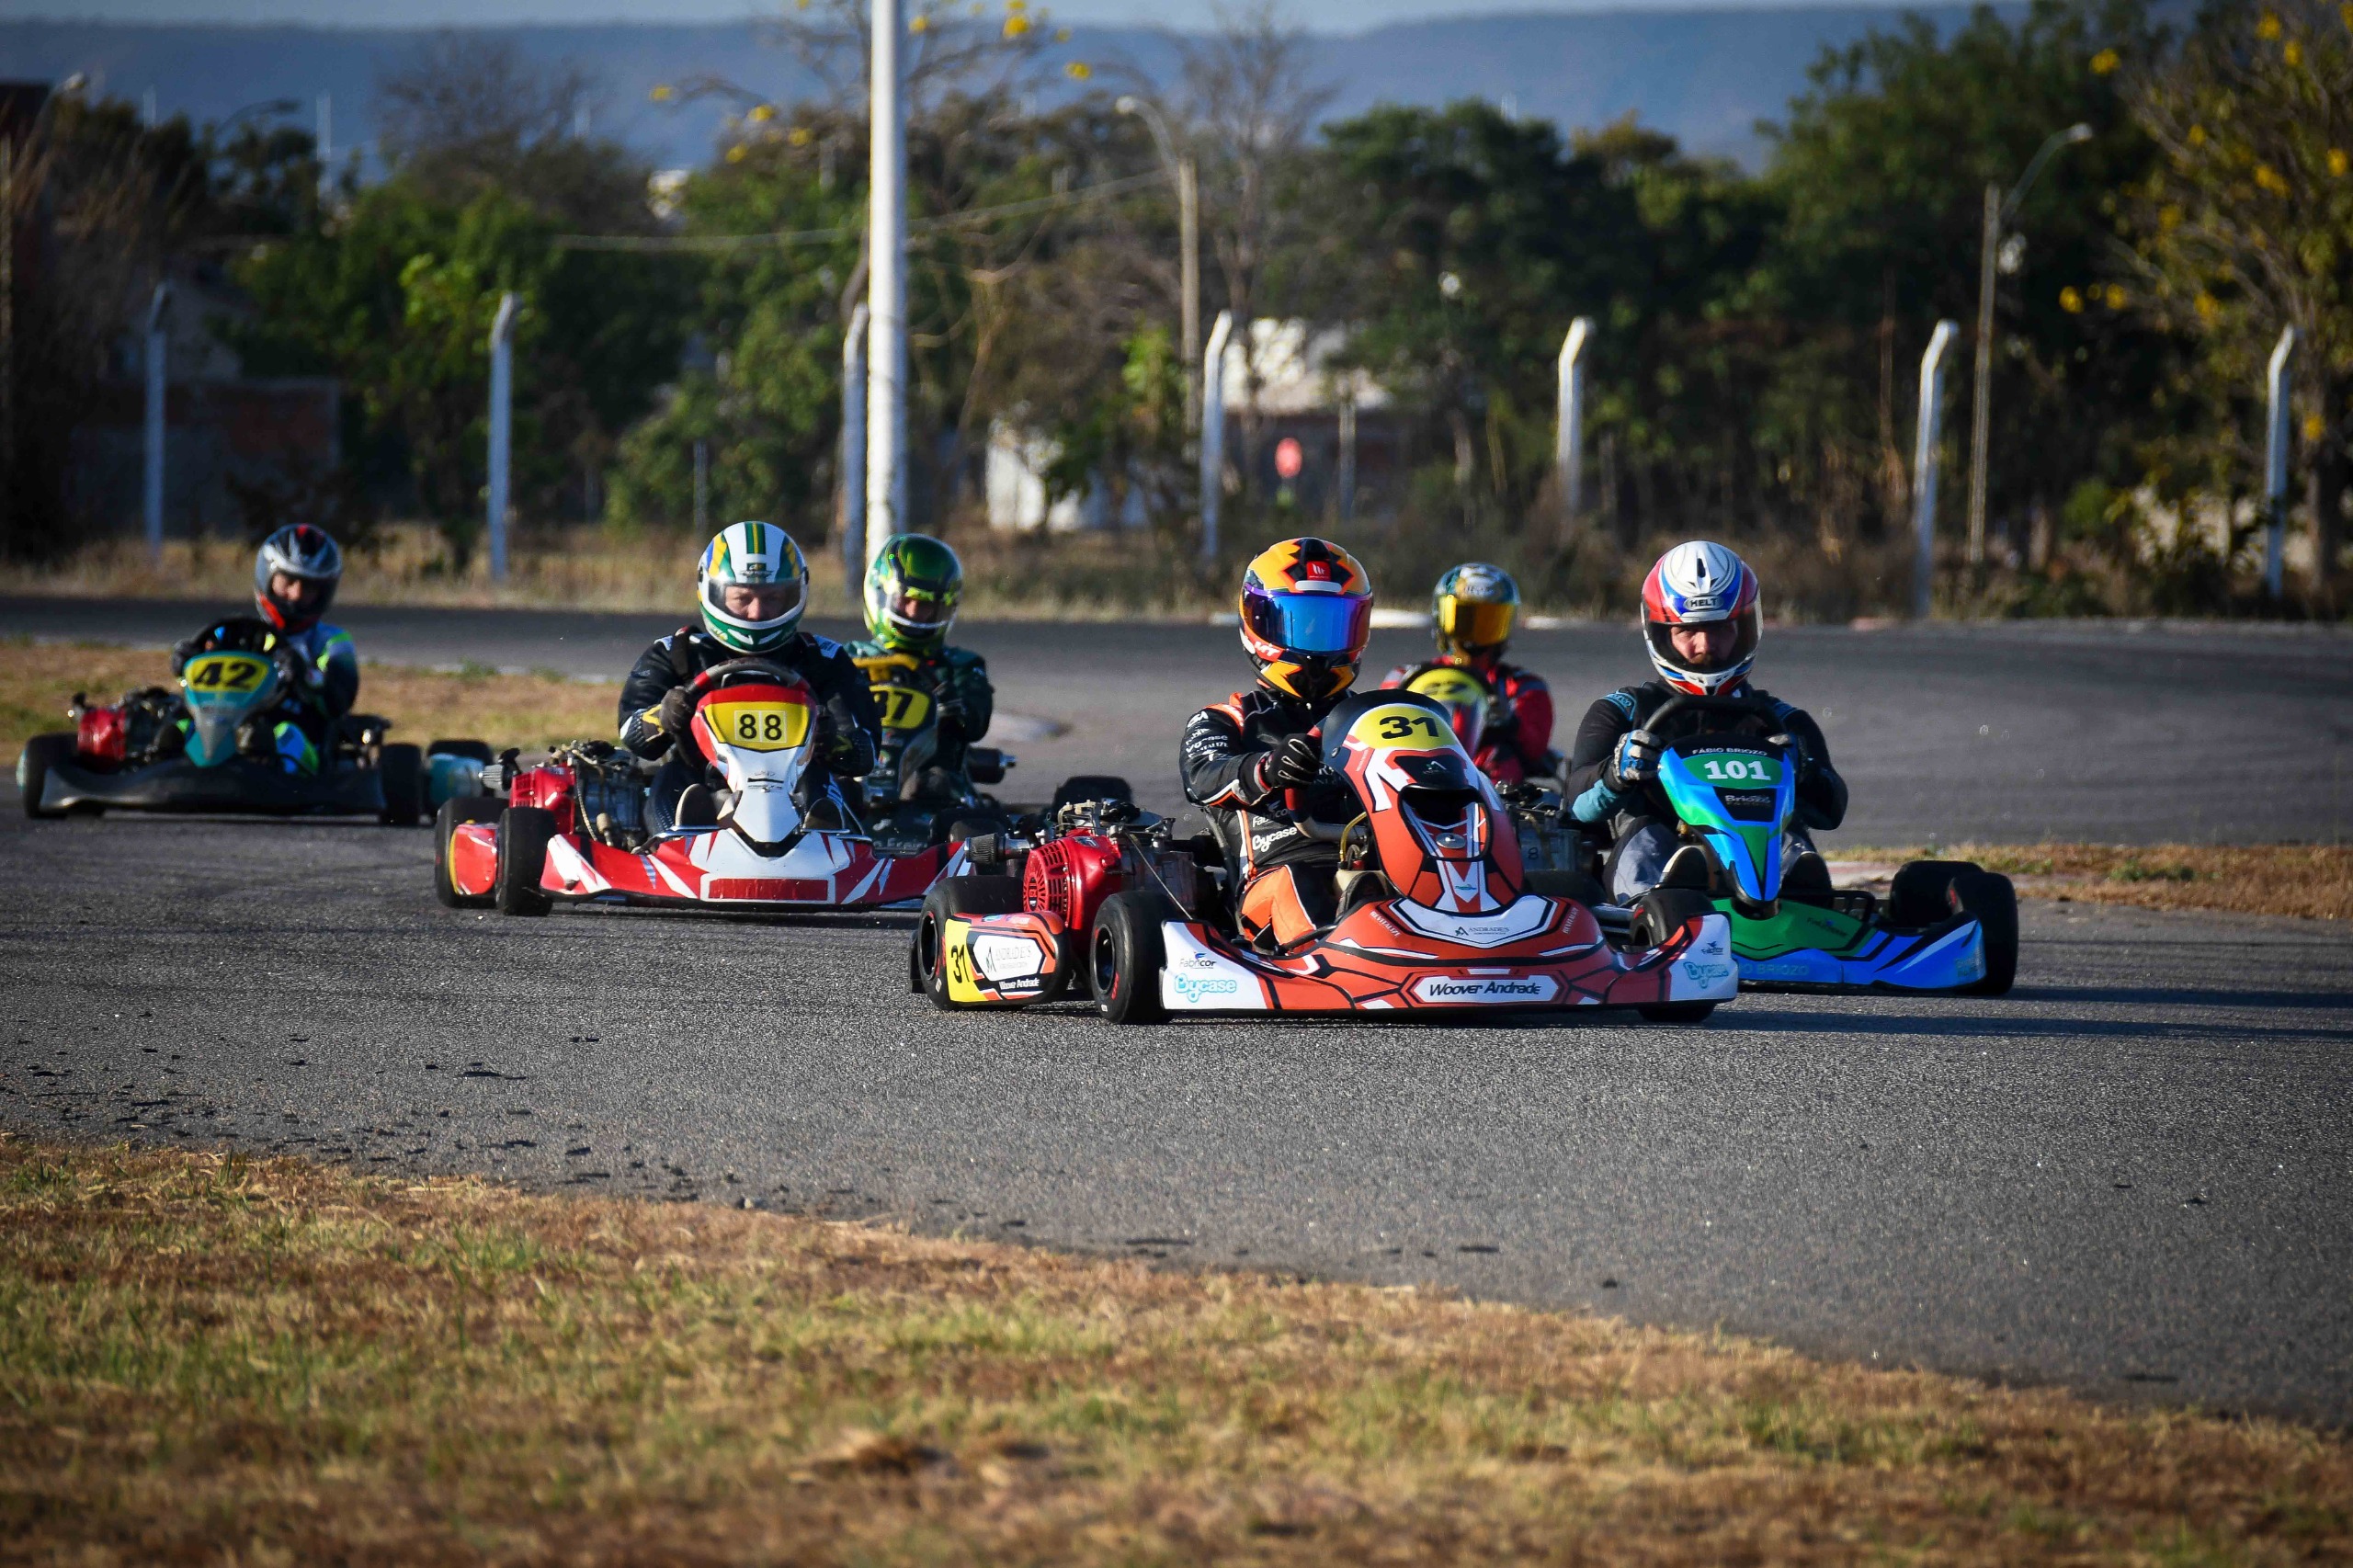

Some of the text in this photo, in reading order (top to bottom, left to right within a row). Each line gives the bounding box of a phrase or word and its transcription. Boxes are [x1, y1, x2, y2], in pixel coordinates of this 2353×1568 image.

[1690, 598, 1718, 607] HELT
[194, 662, 256, 687] 42
[739, 713, 783, 741] 88
[1379, 716, 1439, 739] 31
[1704, 760, 1772, 780] 101
[1251, 826, 1298, 853] Bycase
[950, 944, 971, 983] 31
[1174, 972, 1237, 1004] Bycase
[1429, 980, 1542, 996] Woover Andrade
